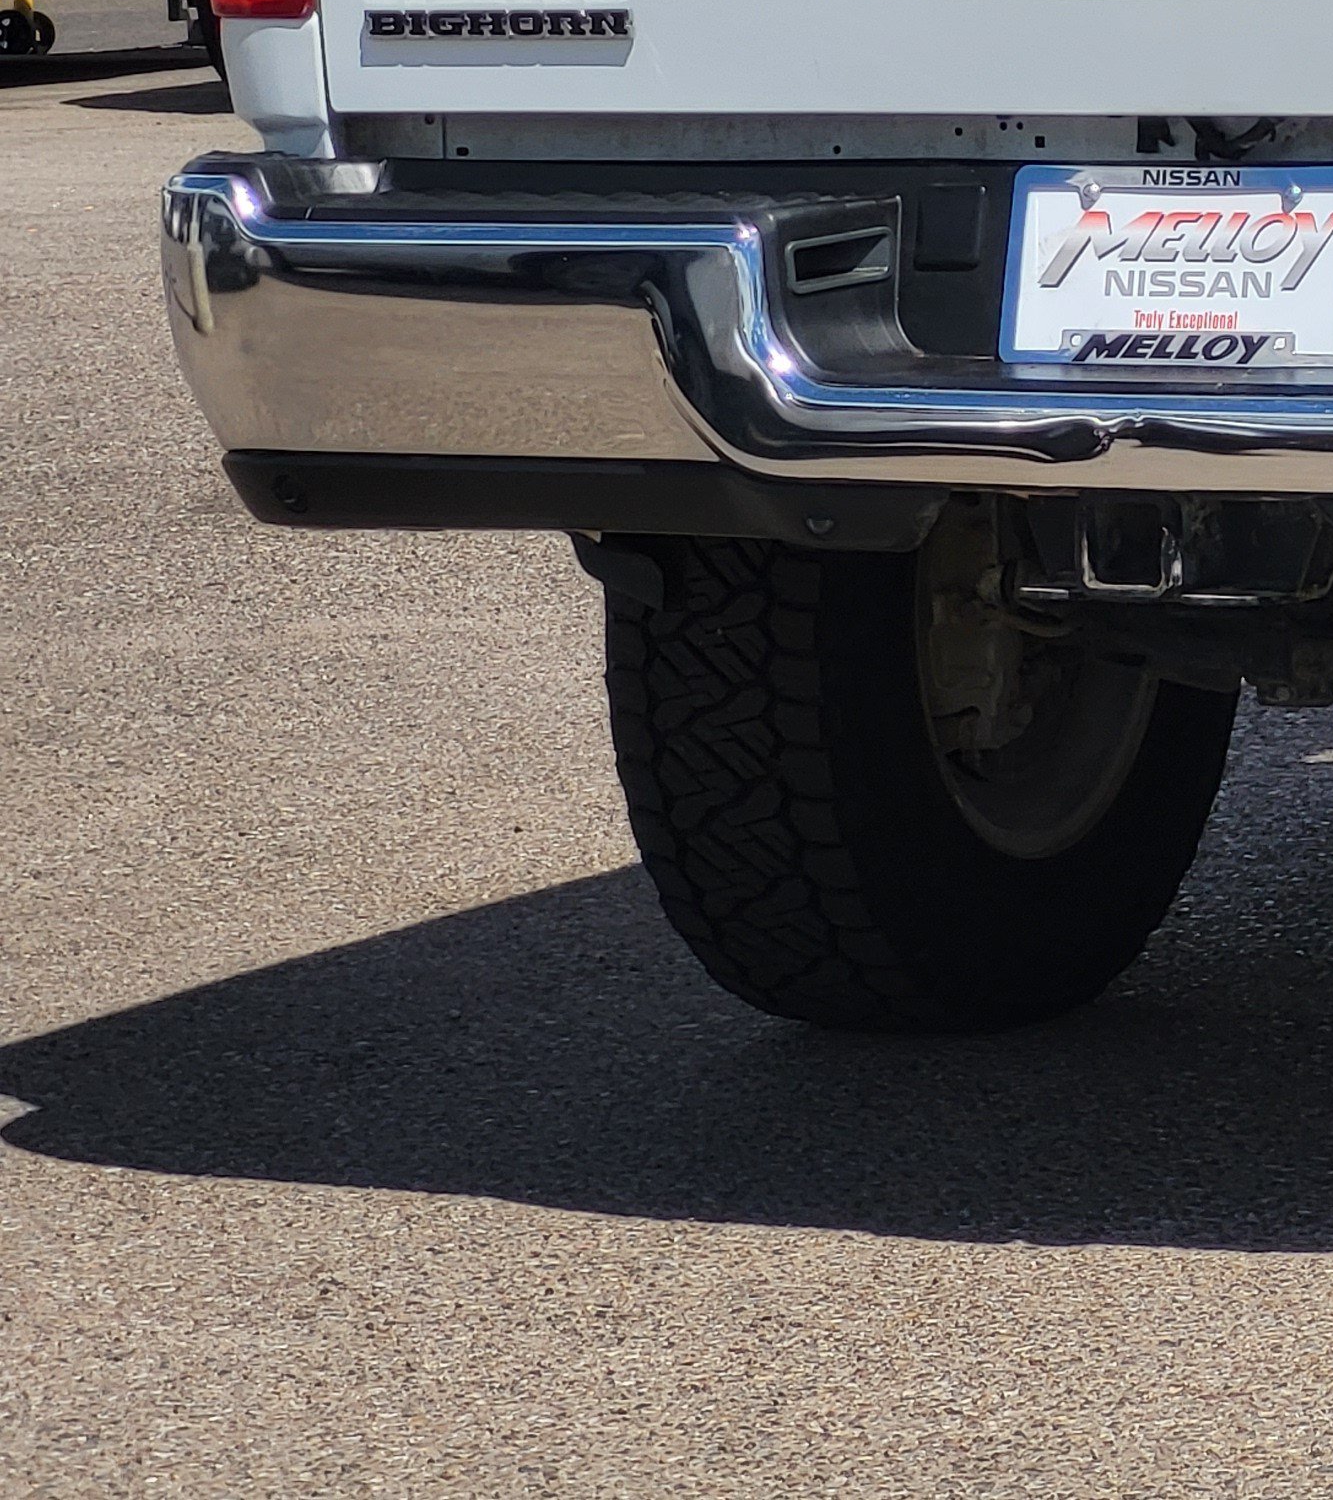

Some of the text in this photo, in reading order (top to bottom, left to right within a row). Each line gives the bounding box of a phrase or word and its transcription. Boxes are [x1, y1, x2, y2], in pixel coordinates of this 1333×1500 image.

[366, 9, 630, 37] BIGHORN
[1141, 168, 1241, 187] NISSAN
[1104, 269, 1272, 299] NISSAN
[1134, 309, 1239, 331] Truly Exceptional
[1072, 332, 1271, 364] MELLOY
